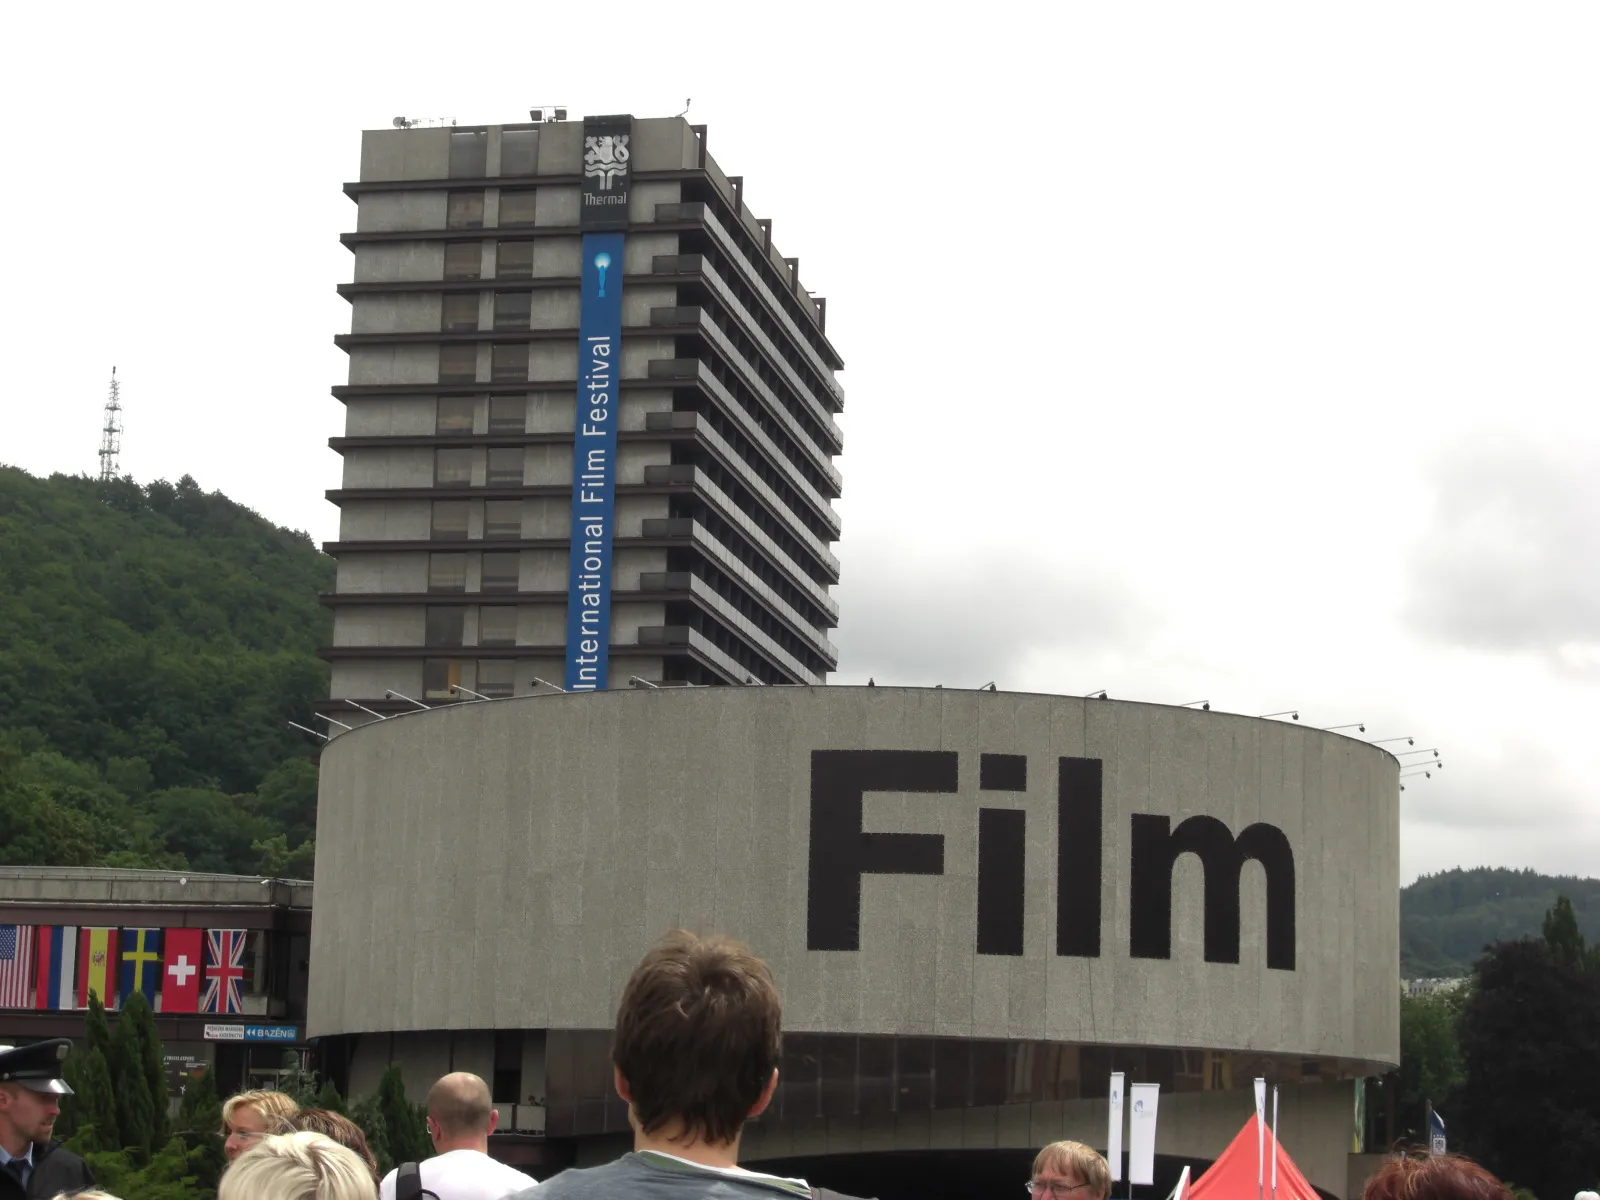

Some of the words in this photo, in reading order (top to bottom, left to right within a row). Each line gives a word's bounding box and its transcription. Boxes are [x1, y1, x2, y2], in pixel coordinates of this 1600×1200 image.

[583, 191, 627, 206] Thermal
[582, 336, 610, 436] Festival
[581, 449, 605, 503] Film
[573, 516, 603, 689] International
[807, 750, 1296, 971] Film
[257, 1027, 287, 1038] BAZÉN
